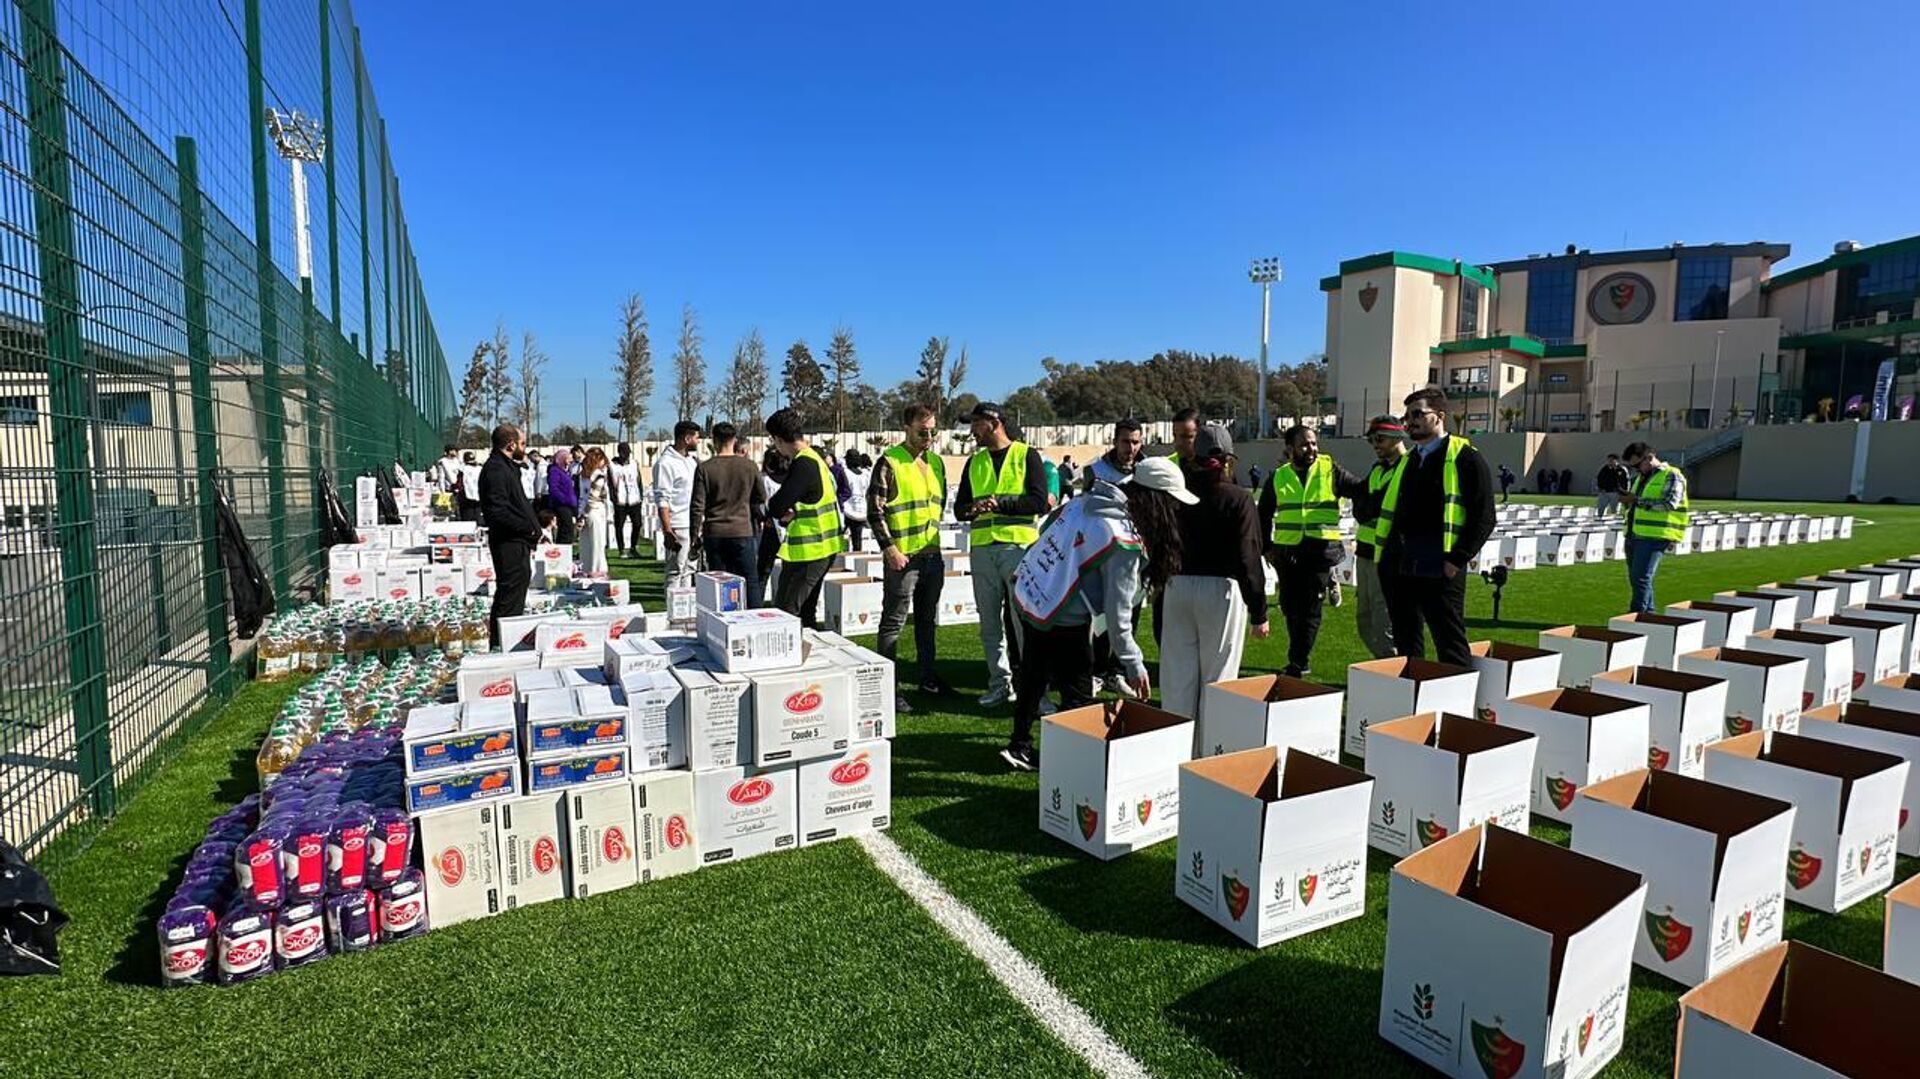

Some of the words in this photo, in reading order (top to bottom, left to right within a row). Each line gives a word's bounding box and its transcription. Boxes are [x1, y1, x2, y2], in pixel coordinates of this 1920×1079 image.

[787, 693, 819, 710] eXtra
[791, 730, 813, 741] Coude
[814, 728, 820, 738] 5
[833, 765, 867, 782] eXtra
[825, 804, 851, 815] Cheveux
[388, 906, 419, 923] SKOR
[285, 932, 319, 949] SKOR
[167, 955, 202, 972] SKOR
[227, 946, 263, 965] SKOR
